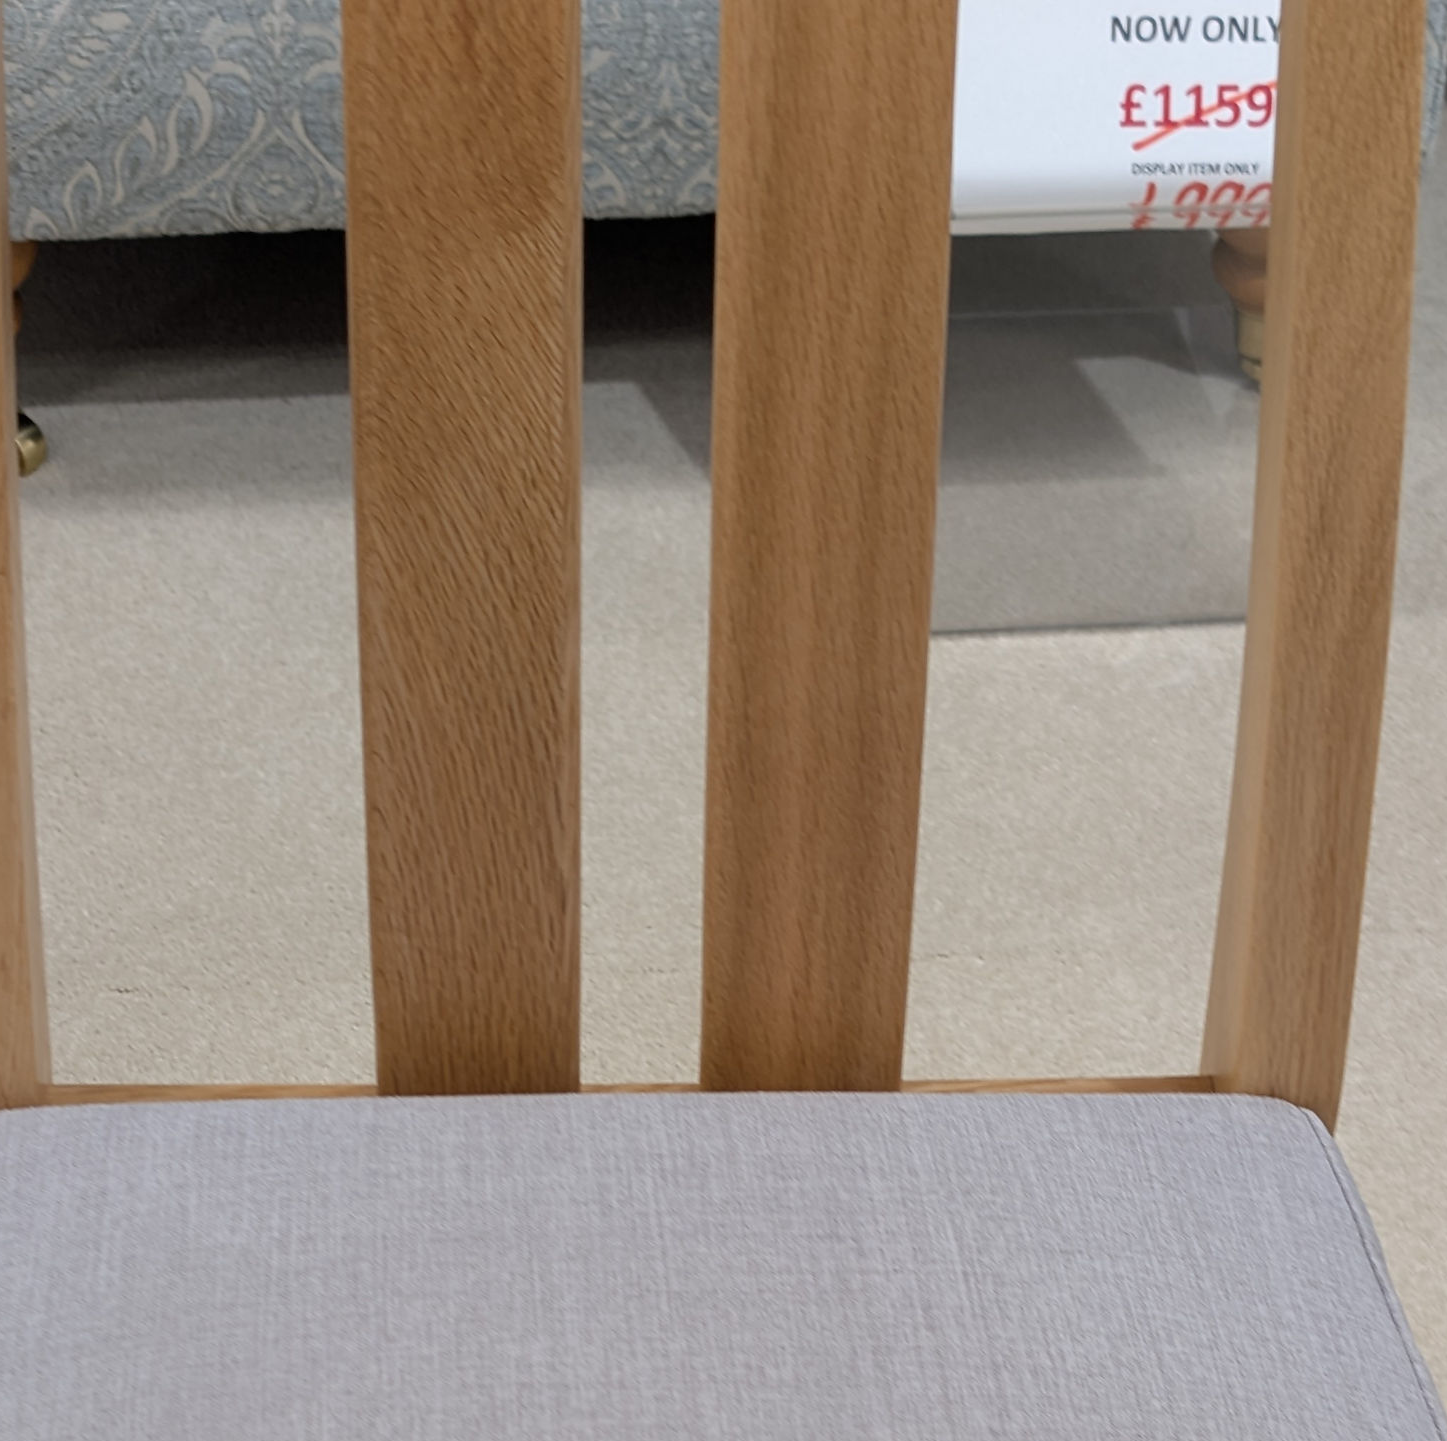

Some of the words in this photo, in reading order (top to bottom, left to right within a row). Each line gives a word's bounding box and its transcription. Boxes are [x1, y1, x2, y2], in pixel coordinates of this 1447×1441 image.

[1111, 15, 1192, 43] NOW
[1202, 15, 1281, 43] ONLY
[1119, 83, 1273, 128] £1159
[1131, 163, 1184, 175] DISPLAY
[1188, 163, 1221, 175] ITEM
[1224, 163, 1260, 175] ONLY
